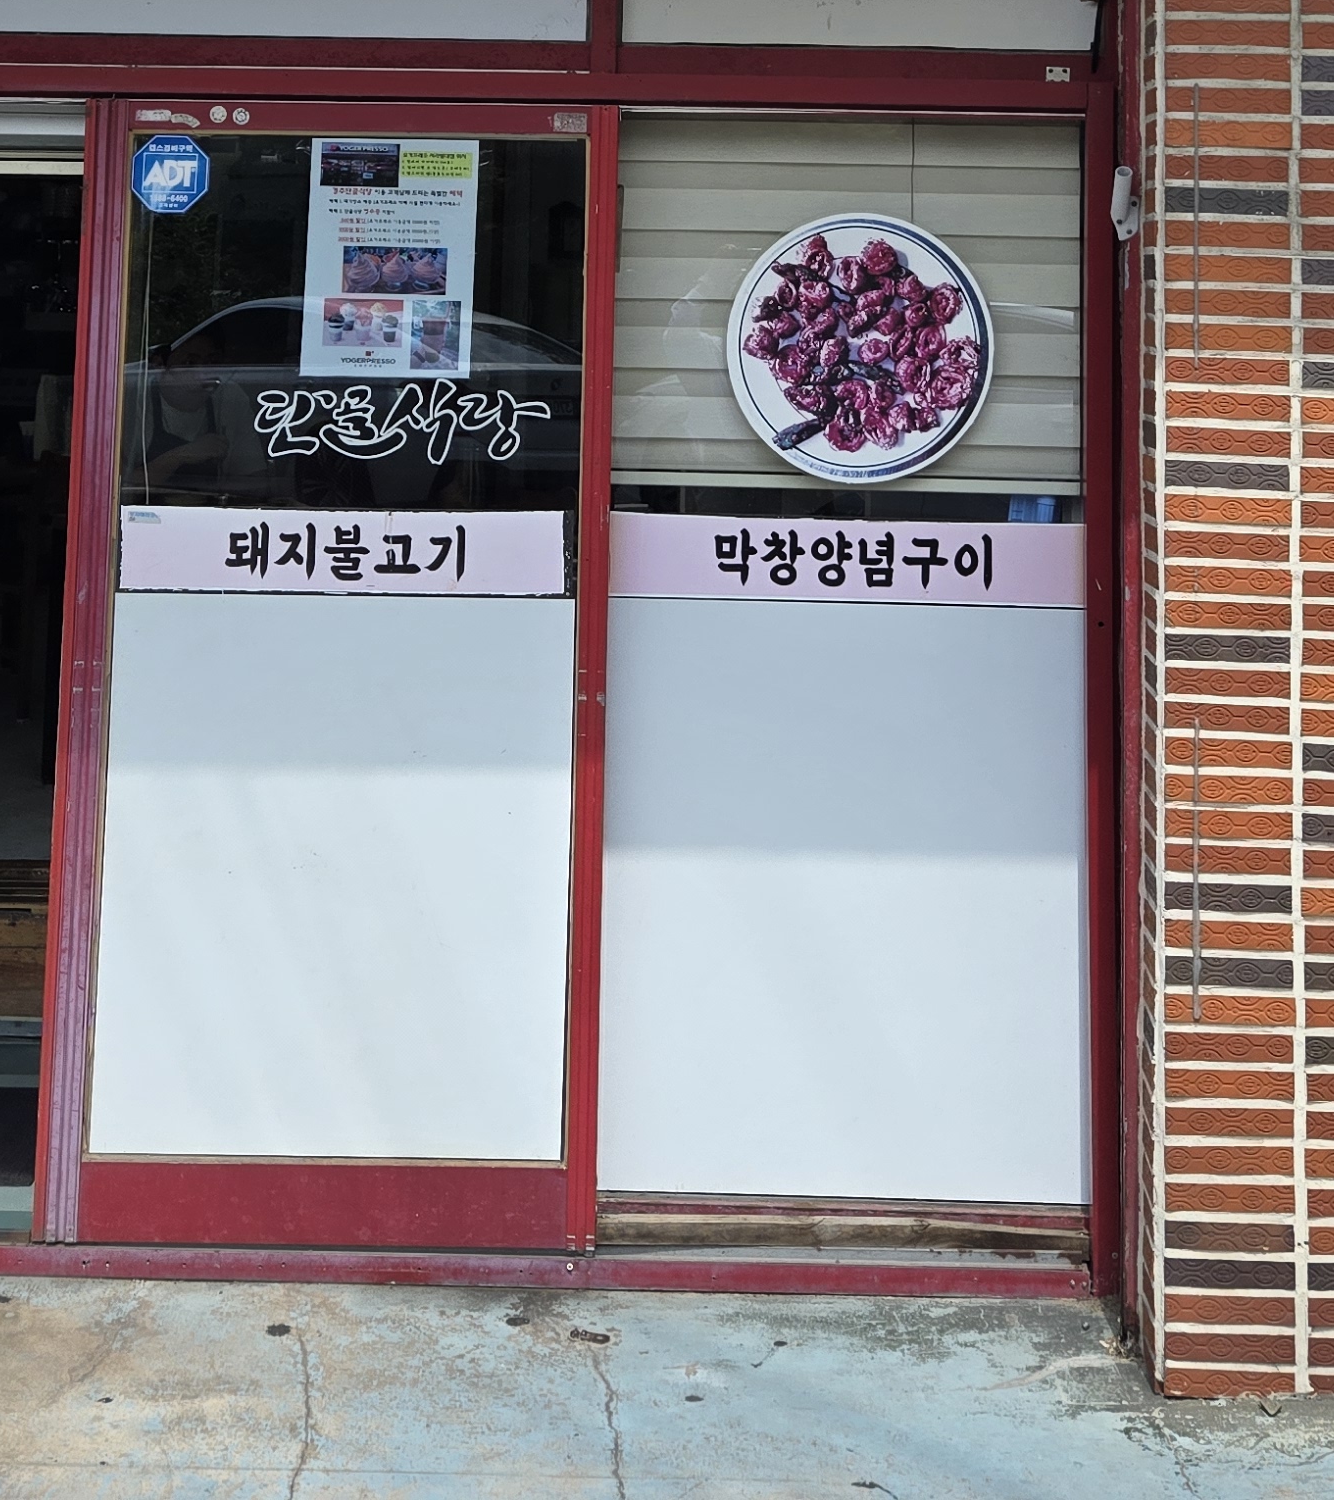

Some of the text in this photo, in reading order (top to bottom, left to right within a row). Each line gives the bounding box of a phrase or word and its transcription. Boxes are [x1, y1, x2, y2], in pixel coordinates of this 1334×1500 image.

[143, 160, 199, 190] ADT
[340, 357, 397, 366] YOGERPRESSO
[253, 378, 552, 466] 단골식당
[224, 522, 466, 582] 돼지불고기
[713, 528, 995, 592] 막창양념구이
